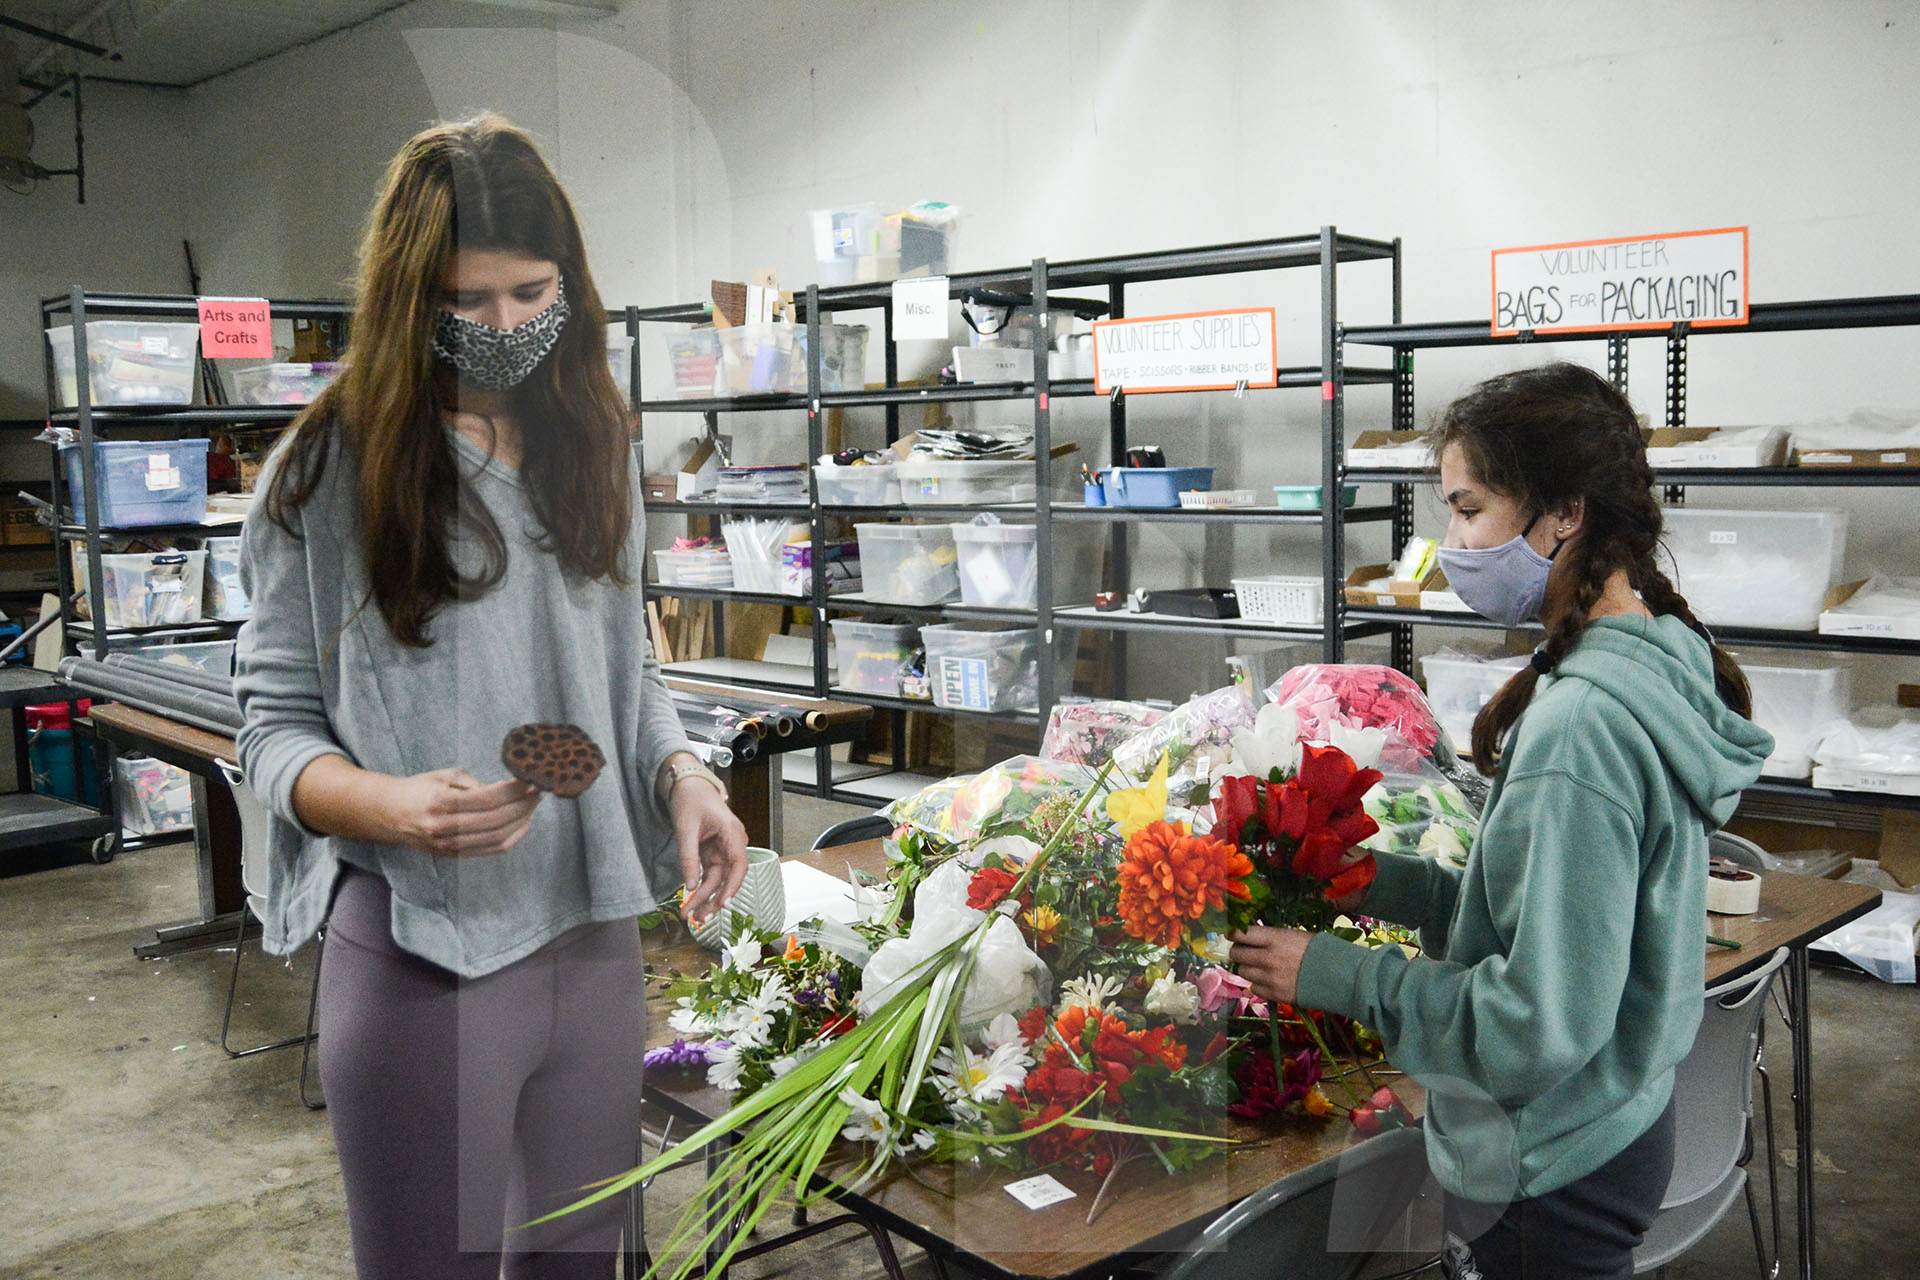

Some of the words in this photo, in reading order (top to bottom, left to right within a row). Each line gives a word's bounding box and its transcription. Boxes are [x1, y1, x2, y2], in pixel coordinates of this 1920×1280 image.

[1540, 240, 1670, 276] VOLUNTEER
[905, 303, 935, 316] Misc.
[1497, 285, 1563, 329] BAGS
[1570, 293, 1597, 309] FOR
[1601, 269, 1738, 323] PACKAGING
[204, 309, 234, 322] Arts
[238, 309, 266, 322] and
[214, 331, 258, 344] Crafts
[1102, 321, 1184, 354] VOLUNTEER
[1191, 314, 1261, 350] SUPPLIES
[1102, 367, 1130, 379] TAPE
[1138, 364, 1184, 377] SCISSORS
[1189, 363, 1218, 375] RUBBER
[1220, 362, 1249, 374] BANDS
[944, 658, 963, 705] OPEN
